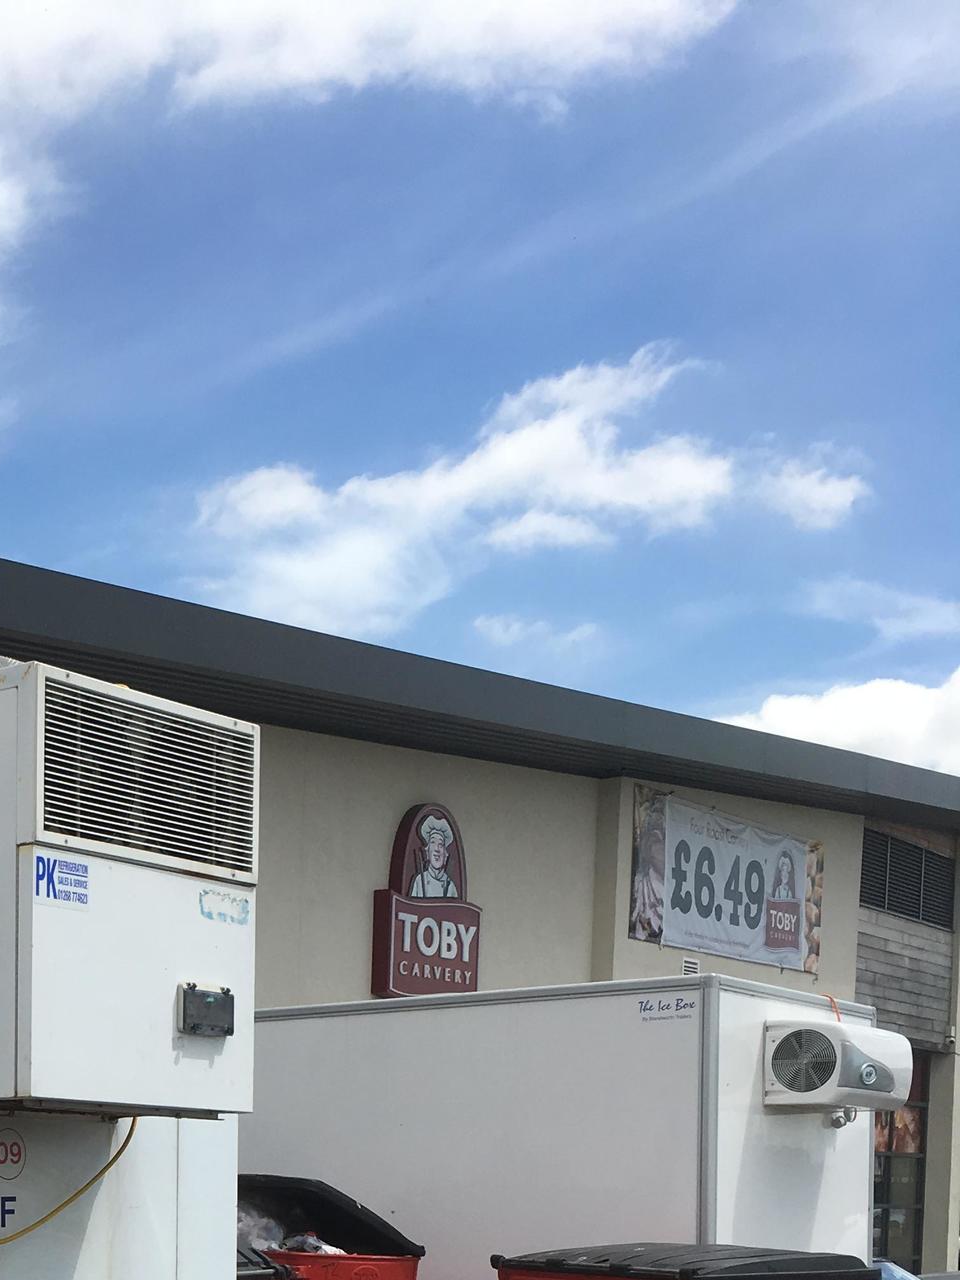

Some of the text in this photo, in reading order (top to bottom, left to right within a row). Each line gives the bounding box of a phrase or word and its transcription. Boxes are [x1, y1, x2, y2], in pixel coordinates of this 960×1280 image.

[36, 855, 58, 900] PK
[770, 909, 797, 933] TOBY
[398, 911, 477, 963] TOBY
[399, 960, 472, 985] CARVERY
[638, 998, 696, 1013] The Ice Box
[0, 1196, 16, 1227] F
